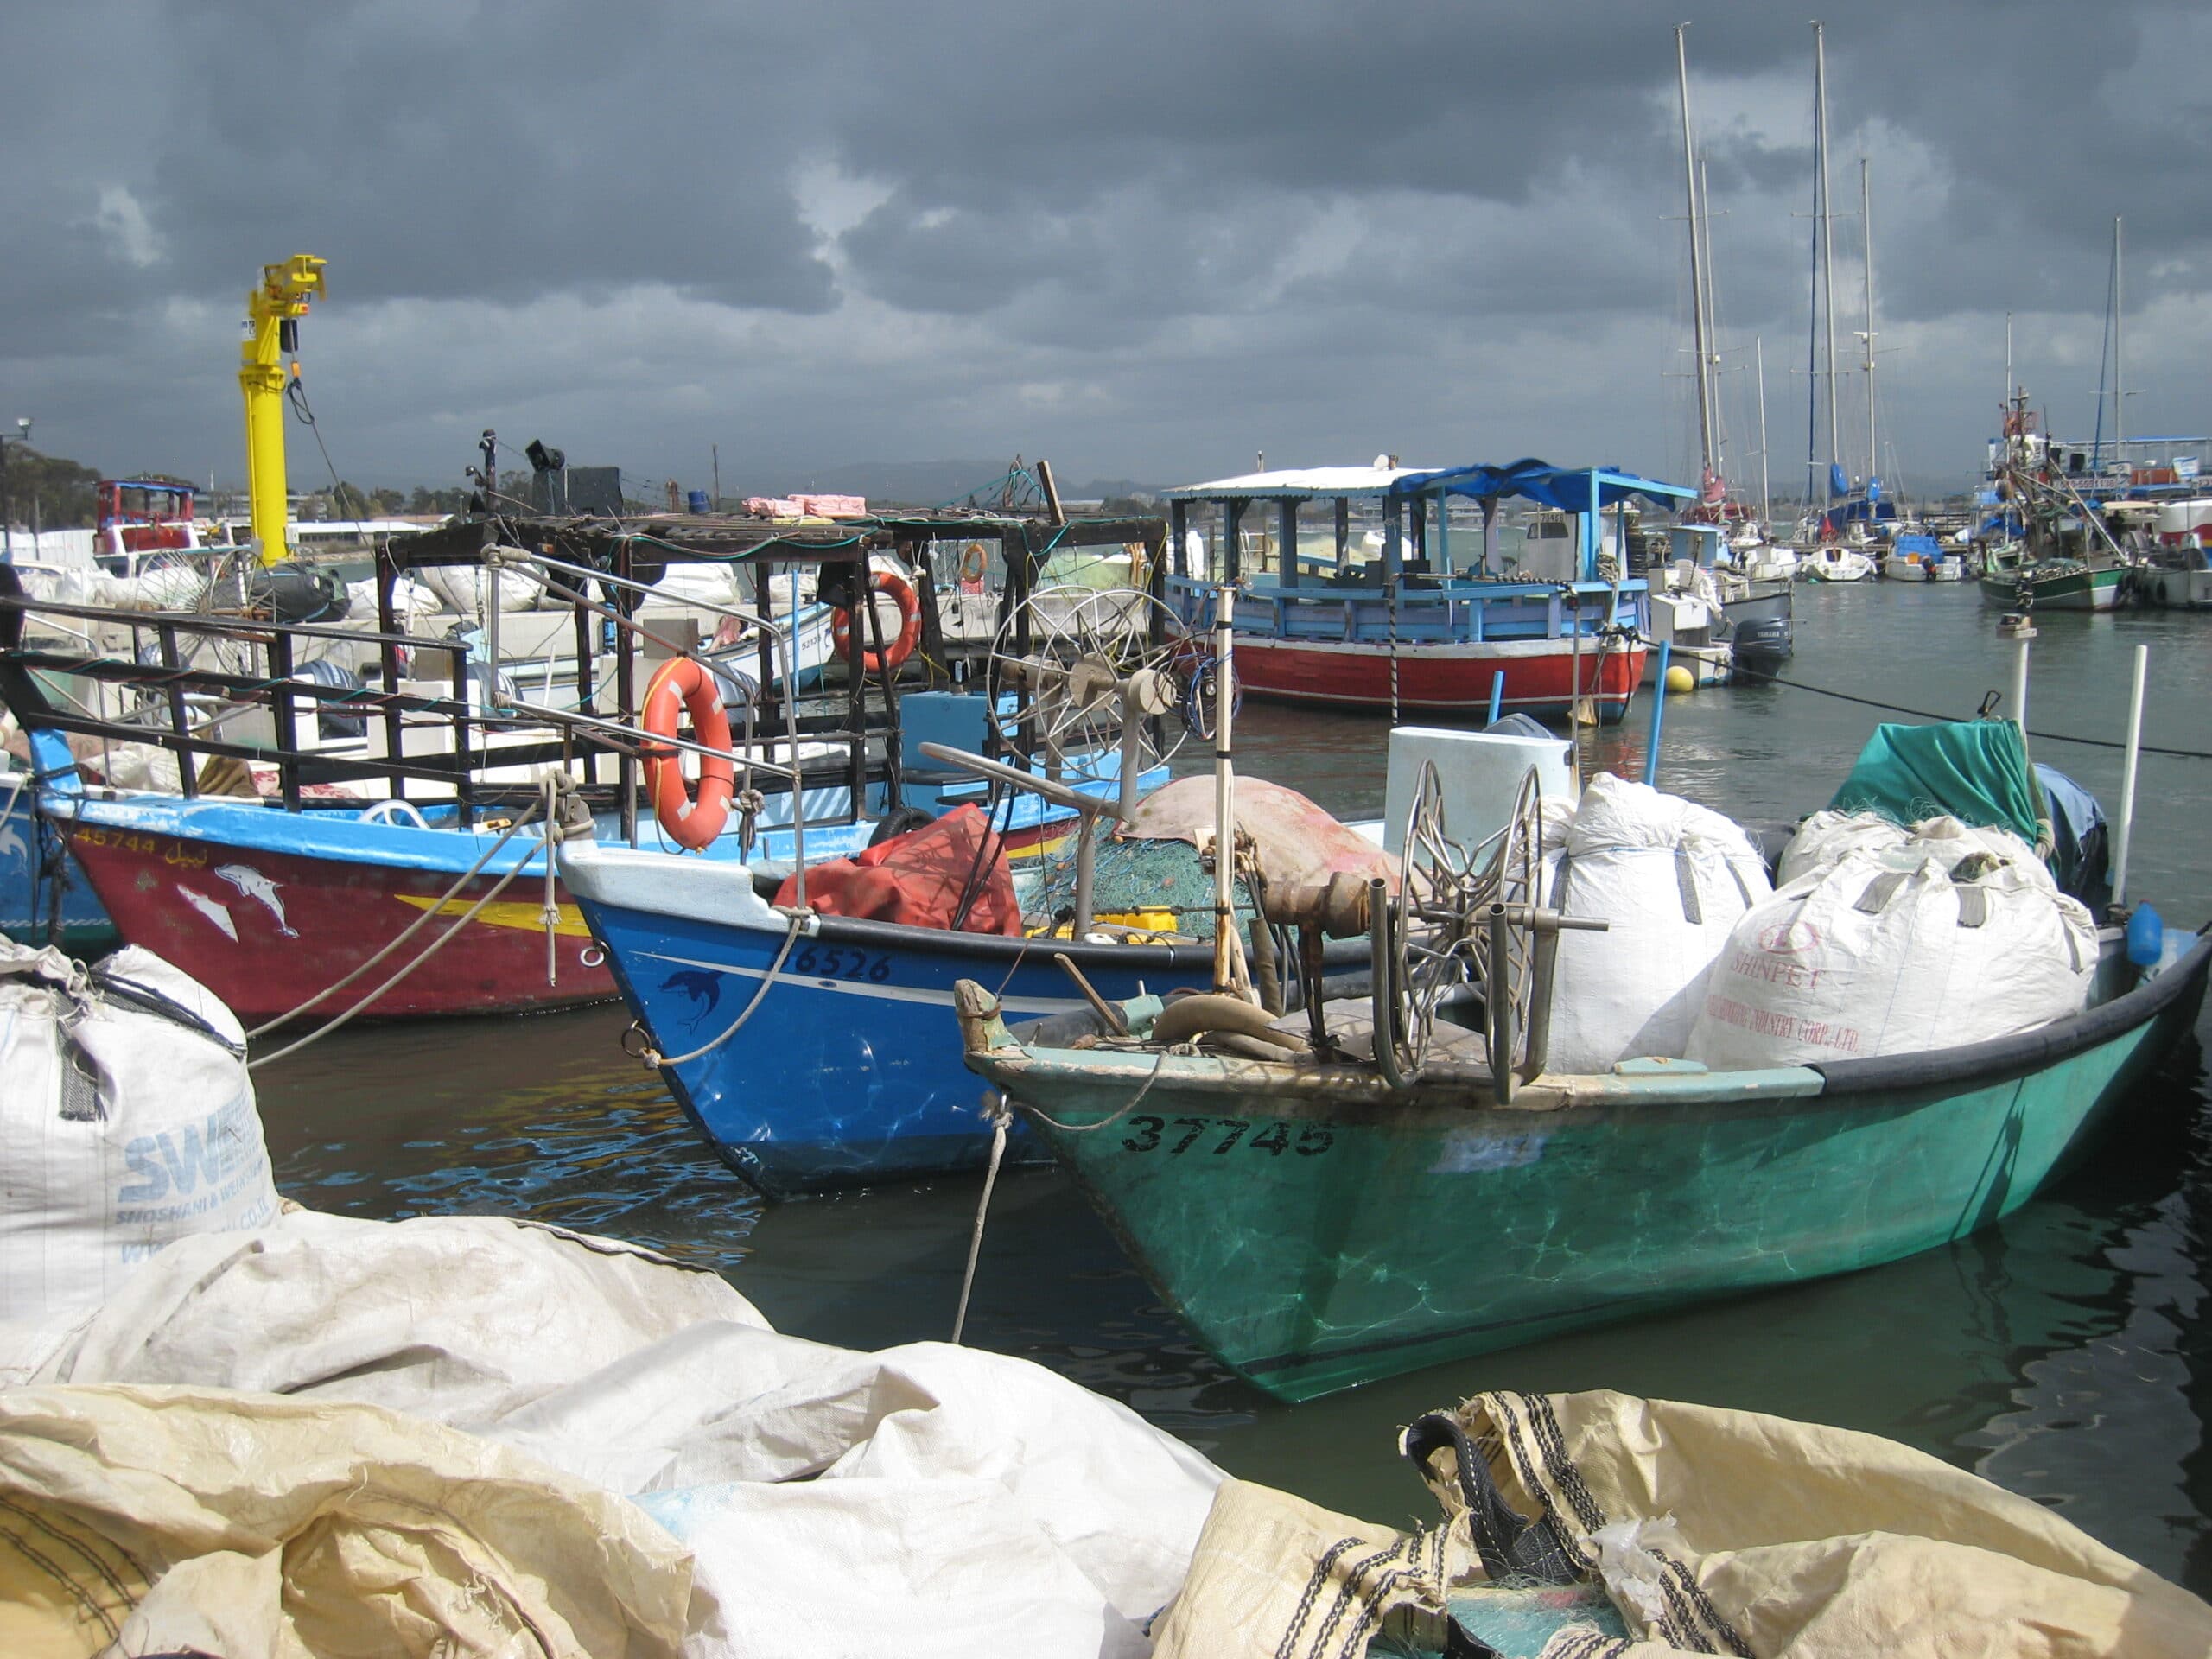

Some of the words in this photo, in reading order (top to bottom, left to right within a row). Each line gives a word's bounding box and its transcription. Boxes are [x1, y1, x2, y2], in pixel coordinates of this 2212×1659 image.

[76, 827, 155, 854] 45744
[1731, 952, 1823, 989] SHINPET
[1122, 1115, 1337, 1157] 37745
[116, 1197, 207, 1224] SHOSHANI
